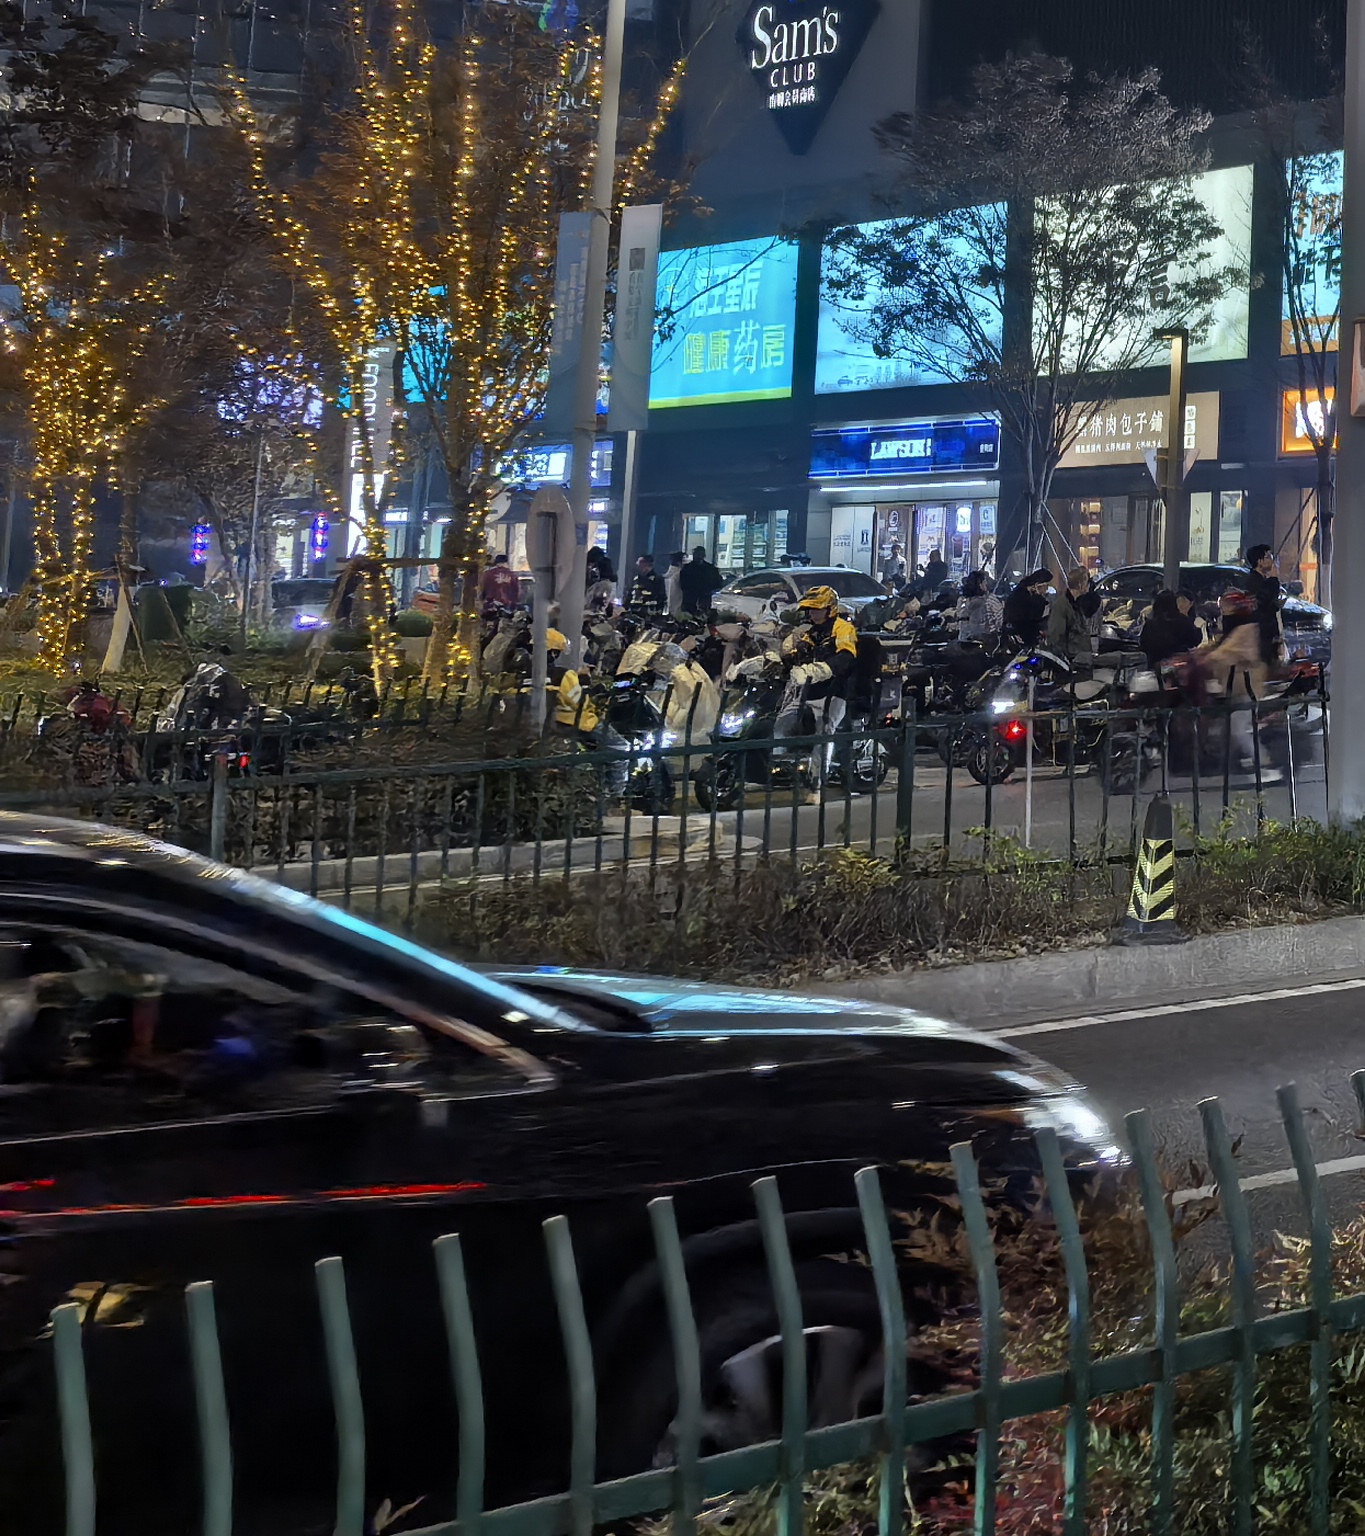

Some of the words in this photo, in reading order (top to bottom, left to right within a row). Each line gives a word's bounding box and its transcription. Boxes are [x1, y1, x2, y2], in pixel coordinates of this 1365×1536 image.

[751, 5, 839, 69] Sam's
[770, 62, 816, 88] CLUB
[684, 319, 786, 376] 健康药房
[870, 439, 926, 460] LAWSON
